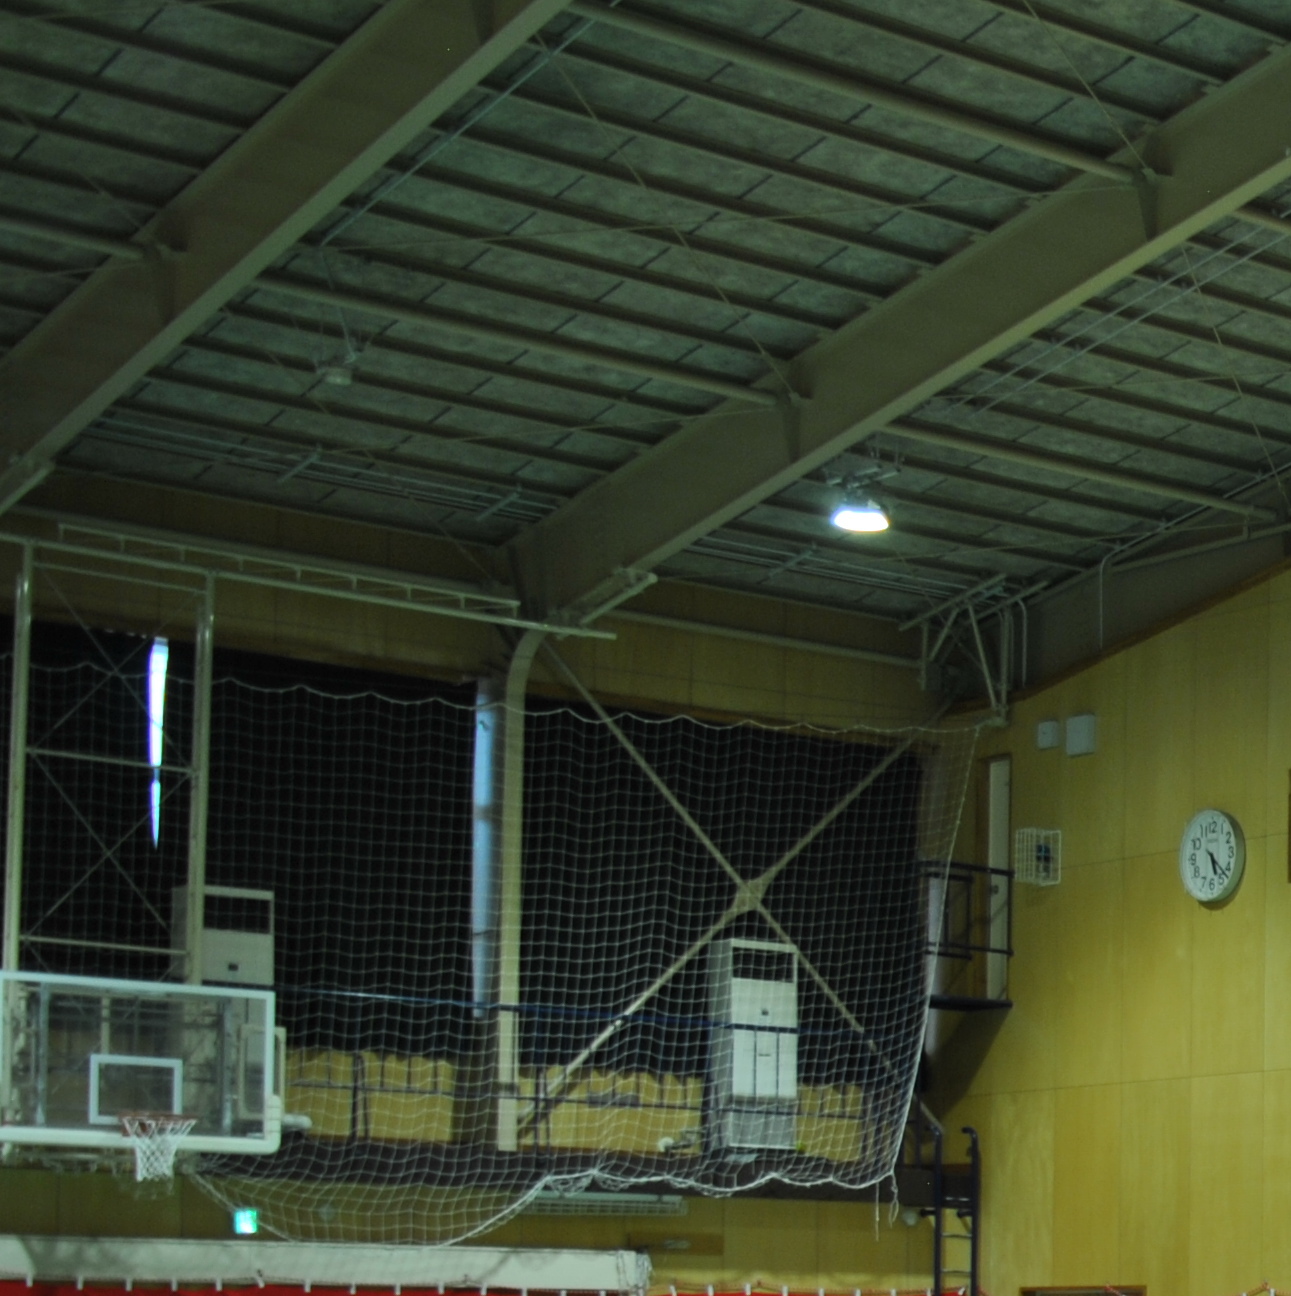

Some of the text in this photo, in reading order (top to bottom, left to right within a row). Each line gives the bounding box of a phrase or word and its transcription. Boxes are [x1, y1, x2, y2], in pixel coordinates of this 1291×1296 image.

[1200, 825, 1207, 837] 11
[1209, 821, 1217, 833] 12
[1226, 832, 1232, 843] 2
[1191, 838, 1201, 850] 10
[1228, 847, 1234, 858] 3
[1189, 854, 1196, 865] 9
[1194, 866, 1200, 878] 8
[1225, 861, 1231, 872] 4
[1201, 877, 1207, 888] 7
[1209, 879, 1215, 890] 6
[1218, 874, 1225, 885] 5
